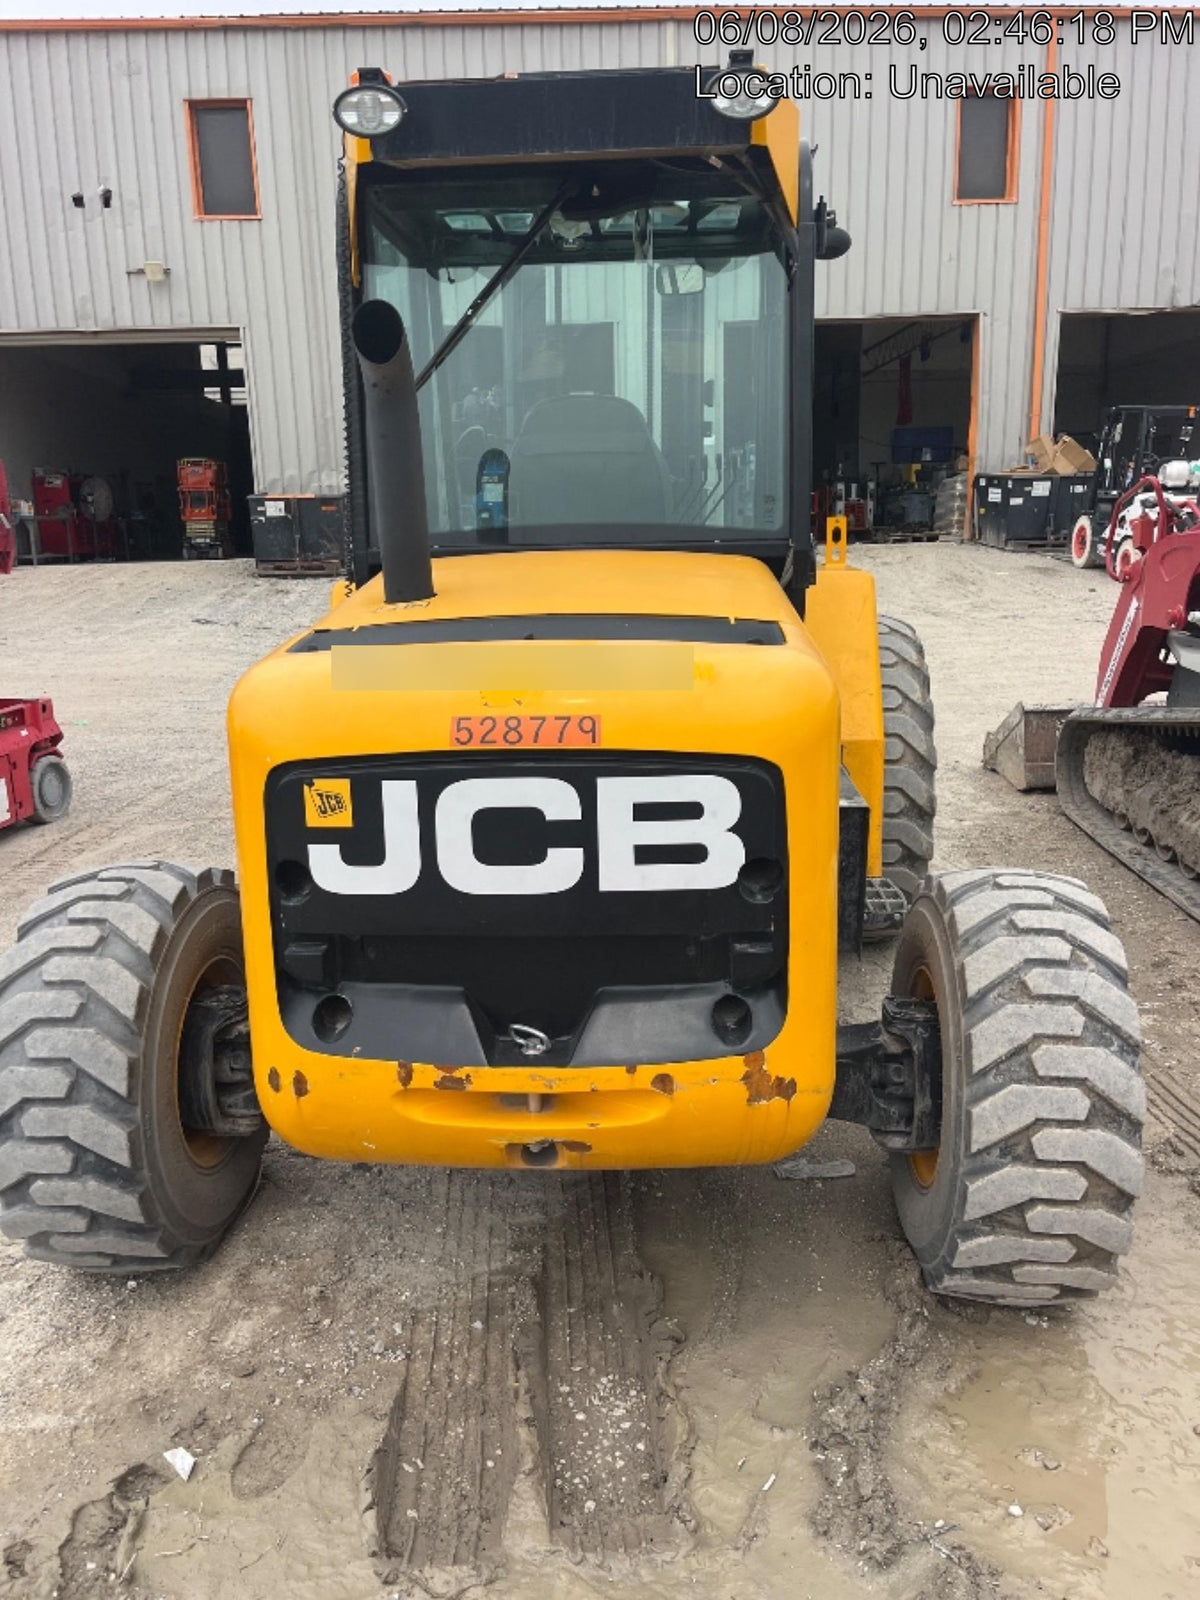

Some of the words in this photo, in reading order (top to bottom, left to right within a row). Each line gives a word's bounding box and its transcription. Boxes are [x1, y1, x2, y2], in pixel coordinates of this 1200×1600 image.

[454, 715, 597, 746] 528779
[315, 792, 344, 815] JCB
[306, 774, 746, 895] JCB
